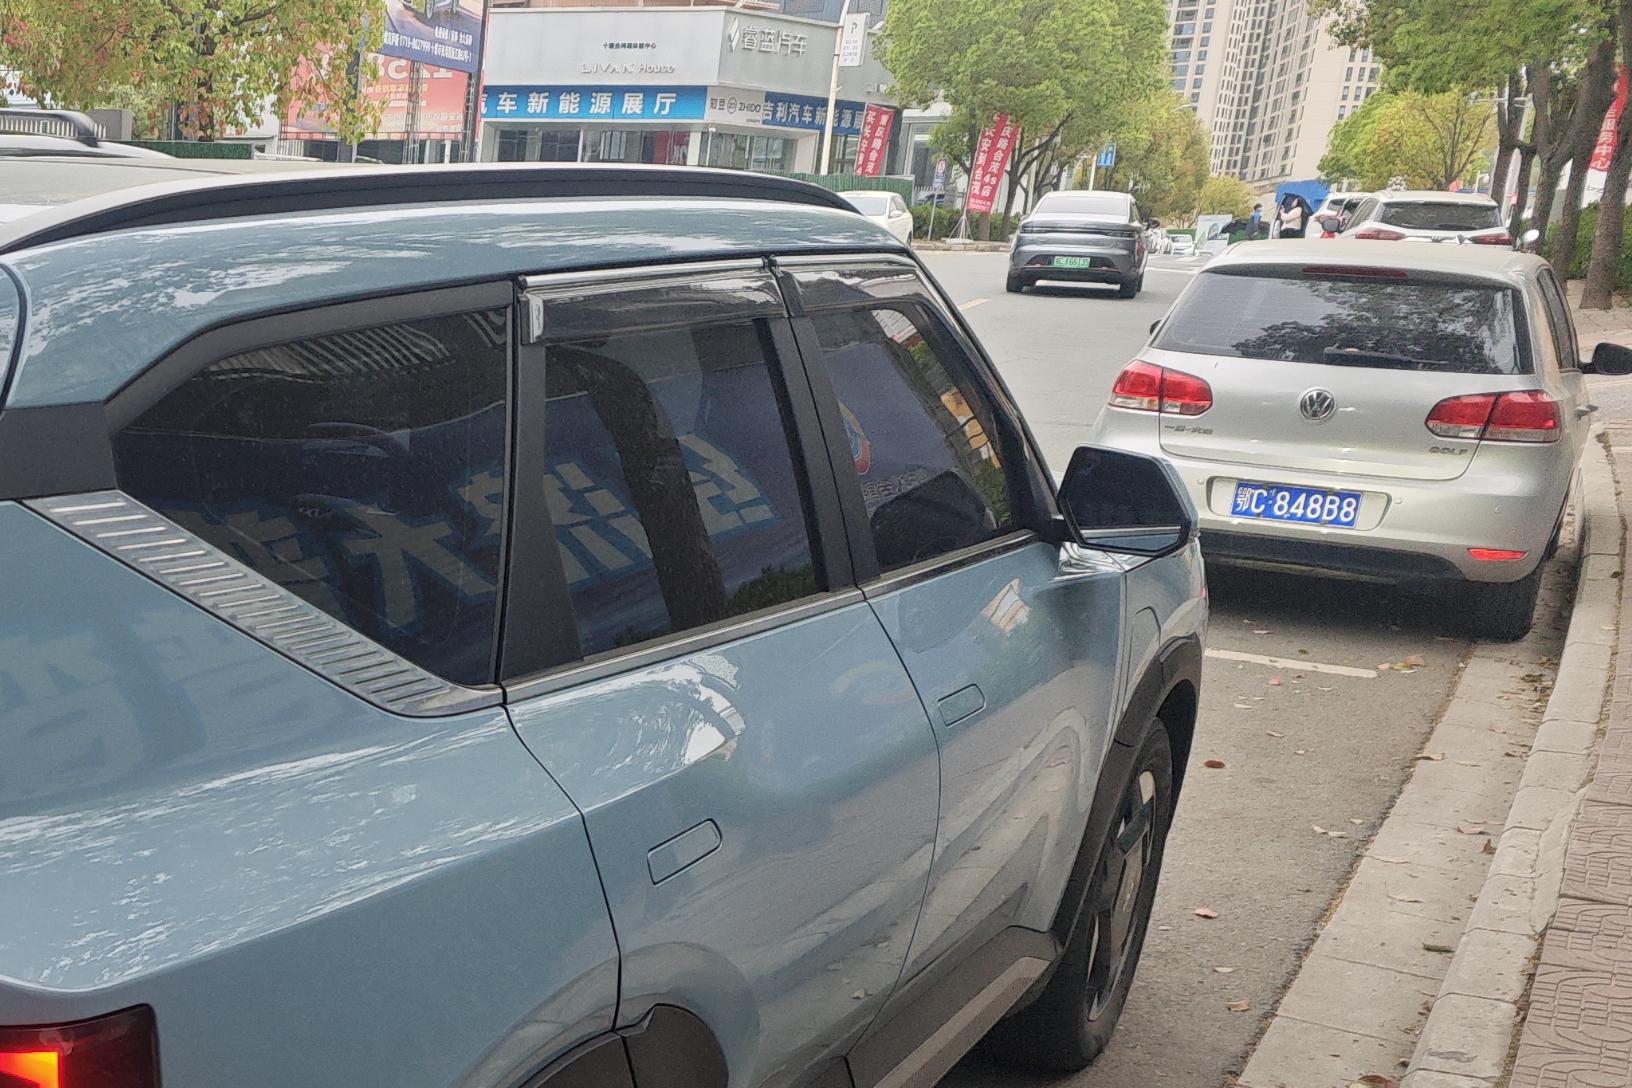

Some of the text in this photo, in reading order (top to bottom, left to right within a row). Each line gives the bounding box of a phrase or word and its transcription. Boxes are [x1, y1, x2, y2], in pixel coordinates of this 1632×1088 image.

[742, 27, 808, 56] 睿蓝汽车
[581, 63, 675, 73] LIVAN House
[710, 97, 725, 110] 知豆
[738, 103, 761, 113] ZHIDO
